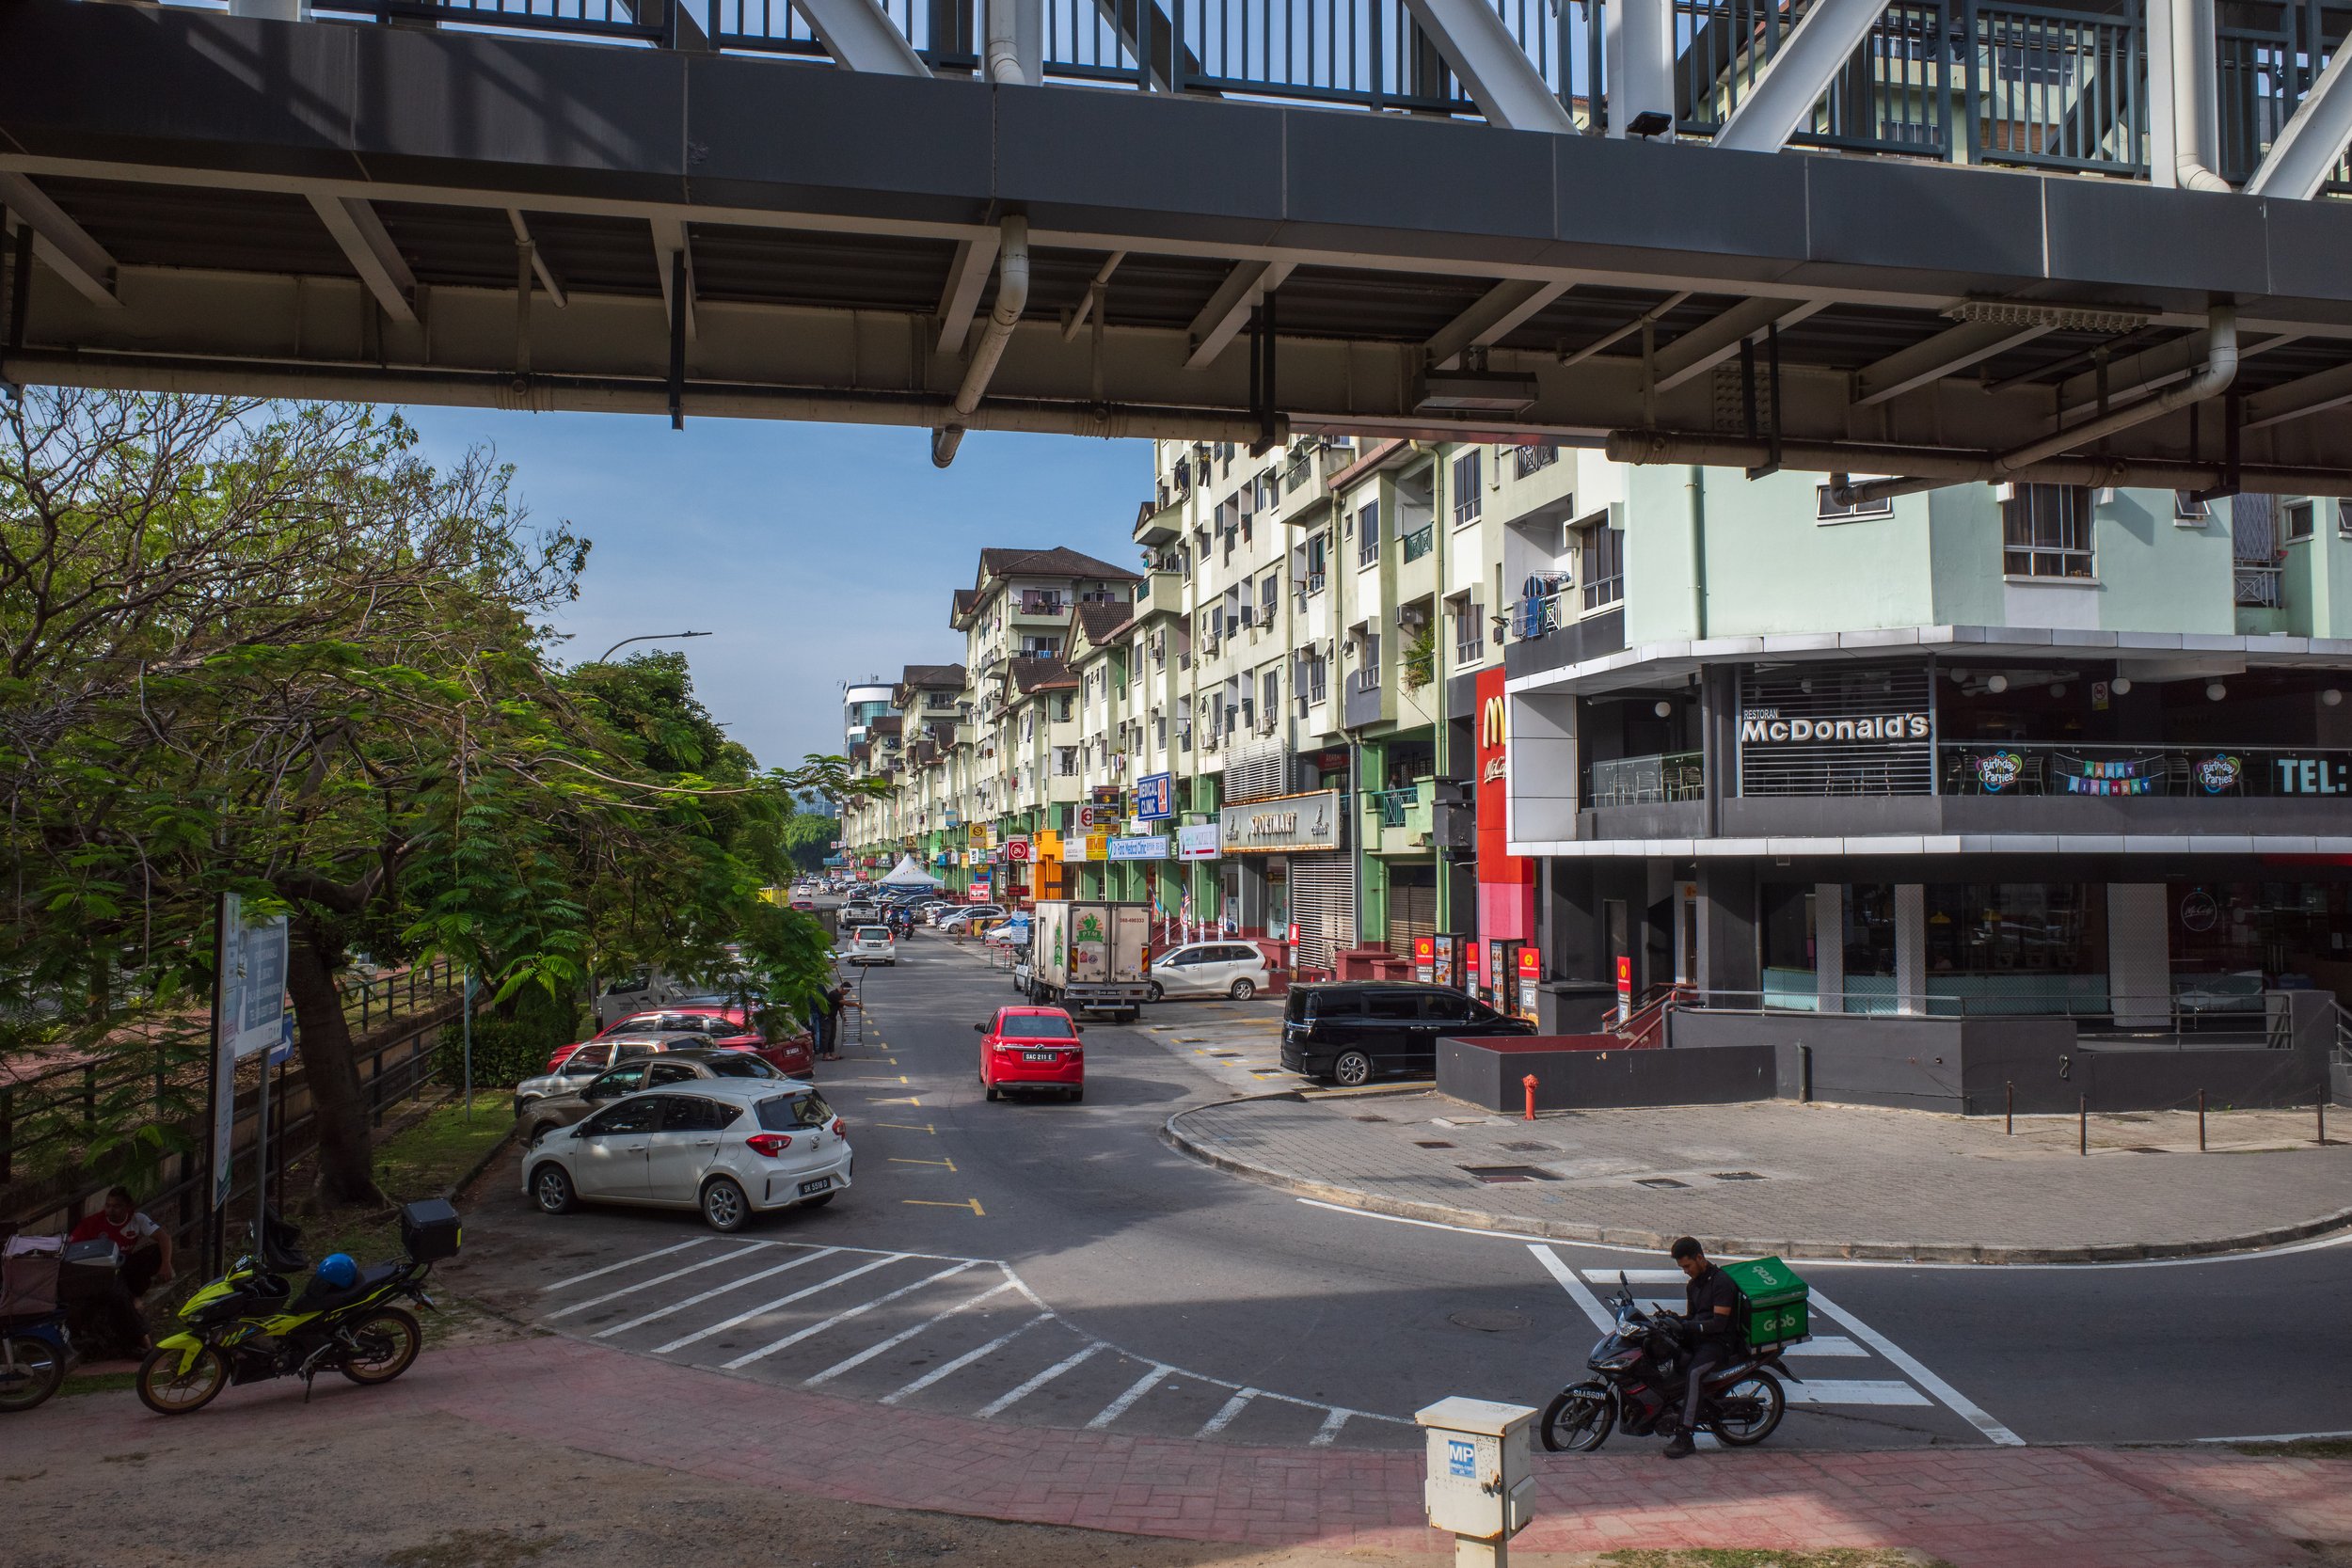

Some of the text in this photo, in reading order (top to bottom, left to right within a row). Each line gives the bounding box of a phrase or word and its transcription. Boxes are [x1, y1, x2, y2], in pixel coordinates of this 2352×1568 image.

[1743, 708, 1778, 720] RESTORAN
[1741, 713, 1929, 742] McDonald's
[1983, 758, 2016, 771] Birthday
[2203, 761, 2235, 774] Birthday
[1985, 771, 2013, 784] Parties
[2205, 774, 2233, 784] Parties
[2277, 758, 2347, 793] TEL:
[1139, 780, 1166, 803] MEDICAL 24
[1141, 798, 1156, 816] CLINIC
[1250, 813, 1297, 836] SPORTMART
[1753, 1265, 1778, 1286] Grab
[1449, 1444, 1474, 1463] MP
